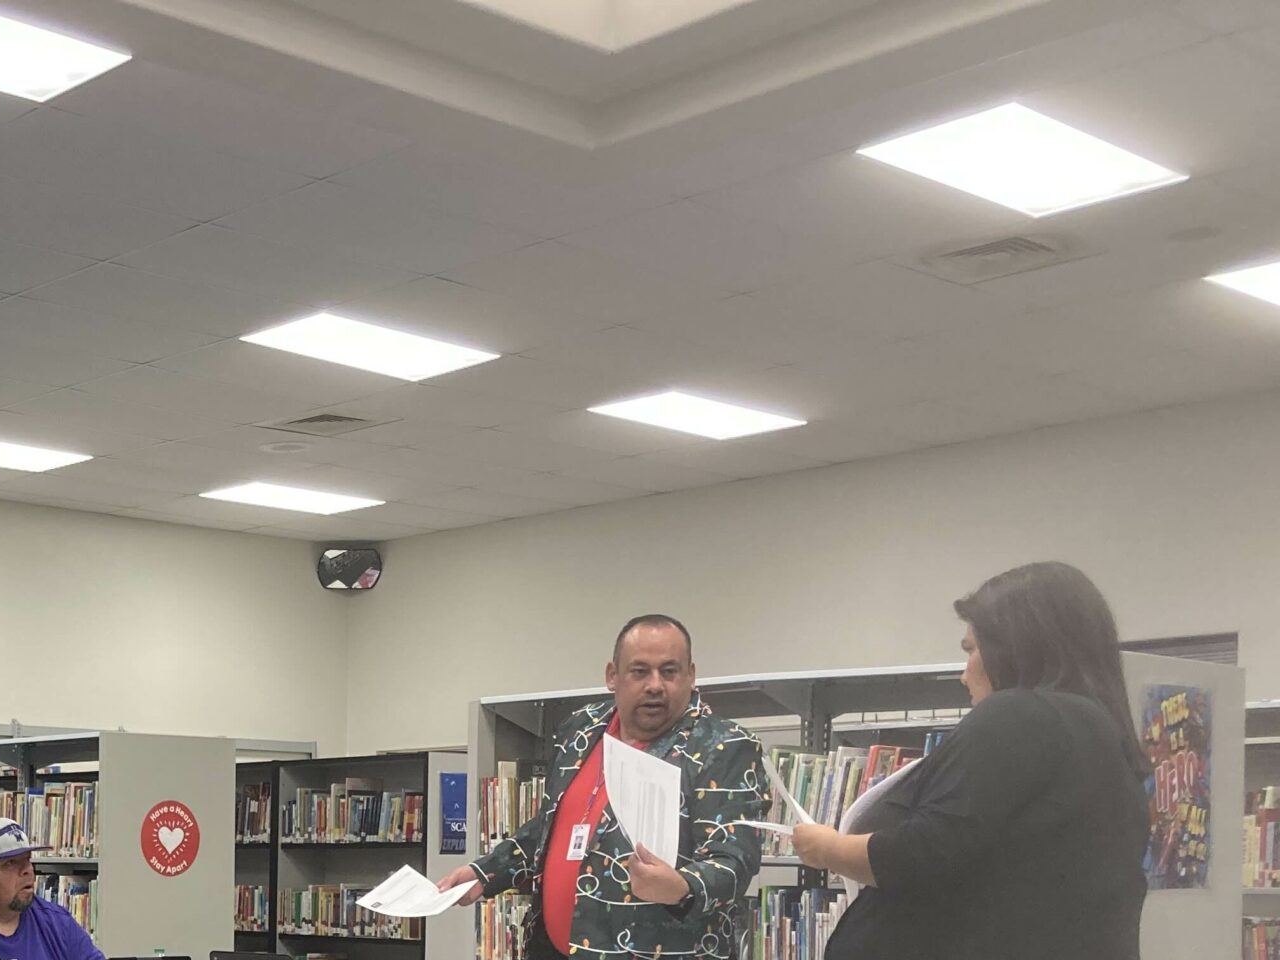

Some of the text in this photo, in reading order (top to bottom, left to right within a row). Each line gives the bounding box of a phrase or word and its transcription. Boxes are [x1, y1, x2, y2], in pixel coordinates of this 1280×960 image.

[1154, 751, 1198, 818] HERO
[150, 806, 169, 822] Have
[175, 806, 194, 828] Heart
[150, 856, 188, 875] Stay Apart
